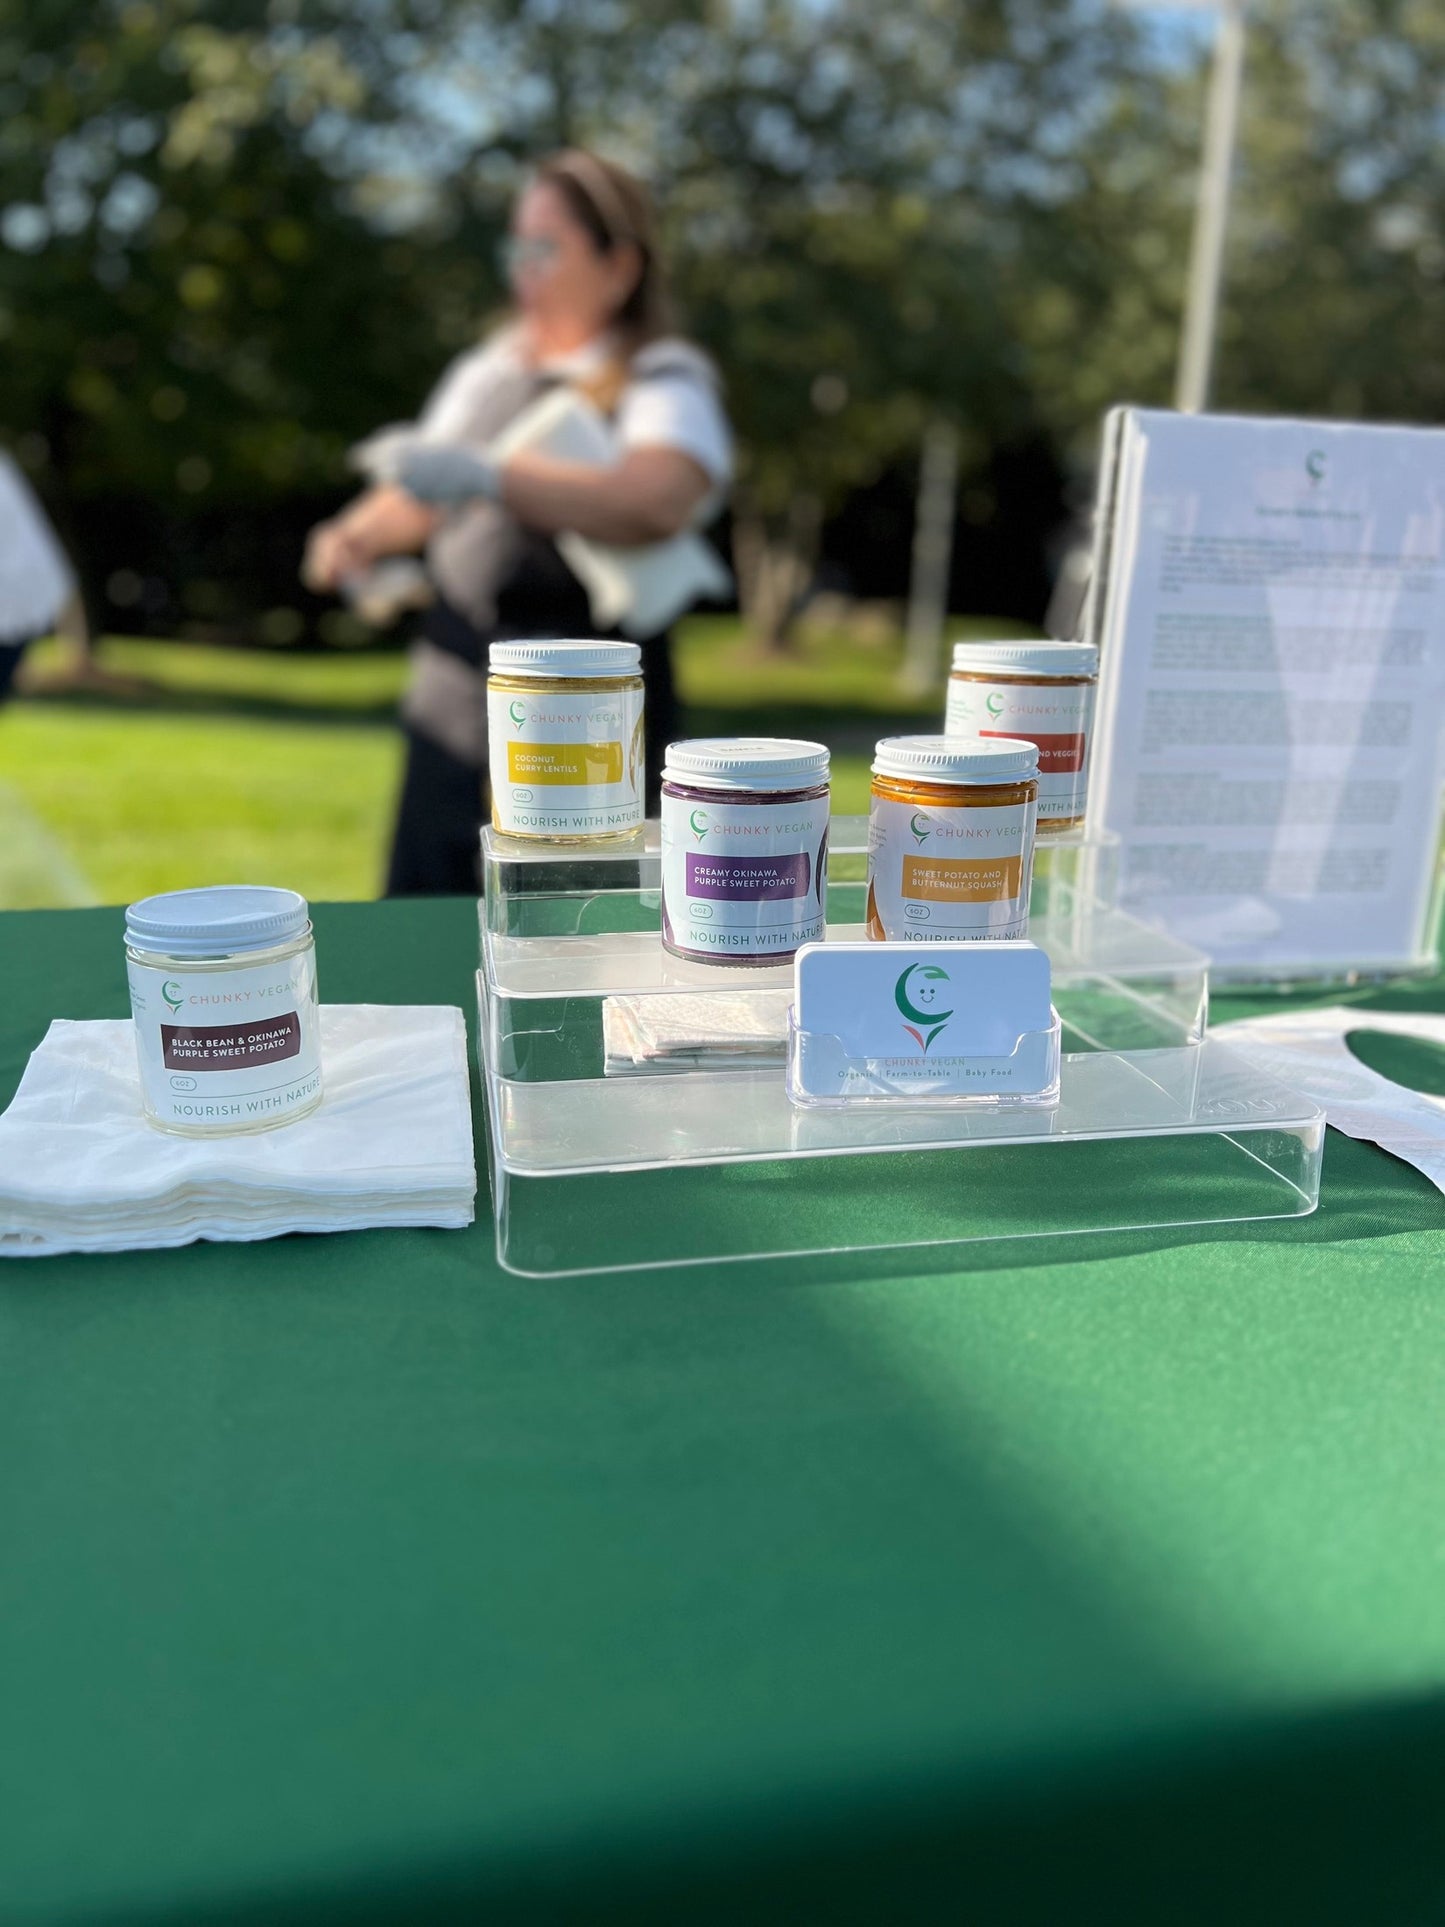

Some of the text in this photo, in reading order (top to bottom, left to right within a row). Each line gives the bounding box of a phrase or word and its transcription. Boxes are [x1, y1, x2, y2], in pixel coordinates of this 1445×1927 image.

[1008, 705, 1090, 715] CHUNKY VEG
[530, 712, 624, 724] CHUNKY VEGAN
[515, 753, 556, 763] COCONUT
[1038, 750, 1051, 758] ND
[515, 764, 578, 774] CURRY LENTILS
[1038, 802, 1064, 812] WITH
[513, 808, 641, 828] NOURISH WITH NATURE
[713, 821, 814, 836] CHUNKY VEGAN
[935, 827, 993, 839] CHUNKY
[694, 866, 778, 878] CREAMY OKINAWA
[912, 868, 1001, 880] SWEET POTATO AND
[694, 876, 797, 888] PURPLE SWEET POTATO
[912, 878, 1002, 890] BUTTERNUT SQUASH
[690, 929, 751, 945] NOURISH
[755, 933, 788, 945] WITH
[188, 979, 299, 1005] CHUNKY VEGAN
[171, 1025, 293, 1049] BLACK BEAN & OKINAWA
[172, 1037, 287, 1059] PURPLE SWEET POTATO
[884, 1058, 967, 1067] CHUNKY VEGAN
[838, 1068, 1013, 1081] Organic Farm-to-Table Baby Food
[172, 1075, 321, 1117] NOURISH WITH NATURE
